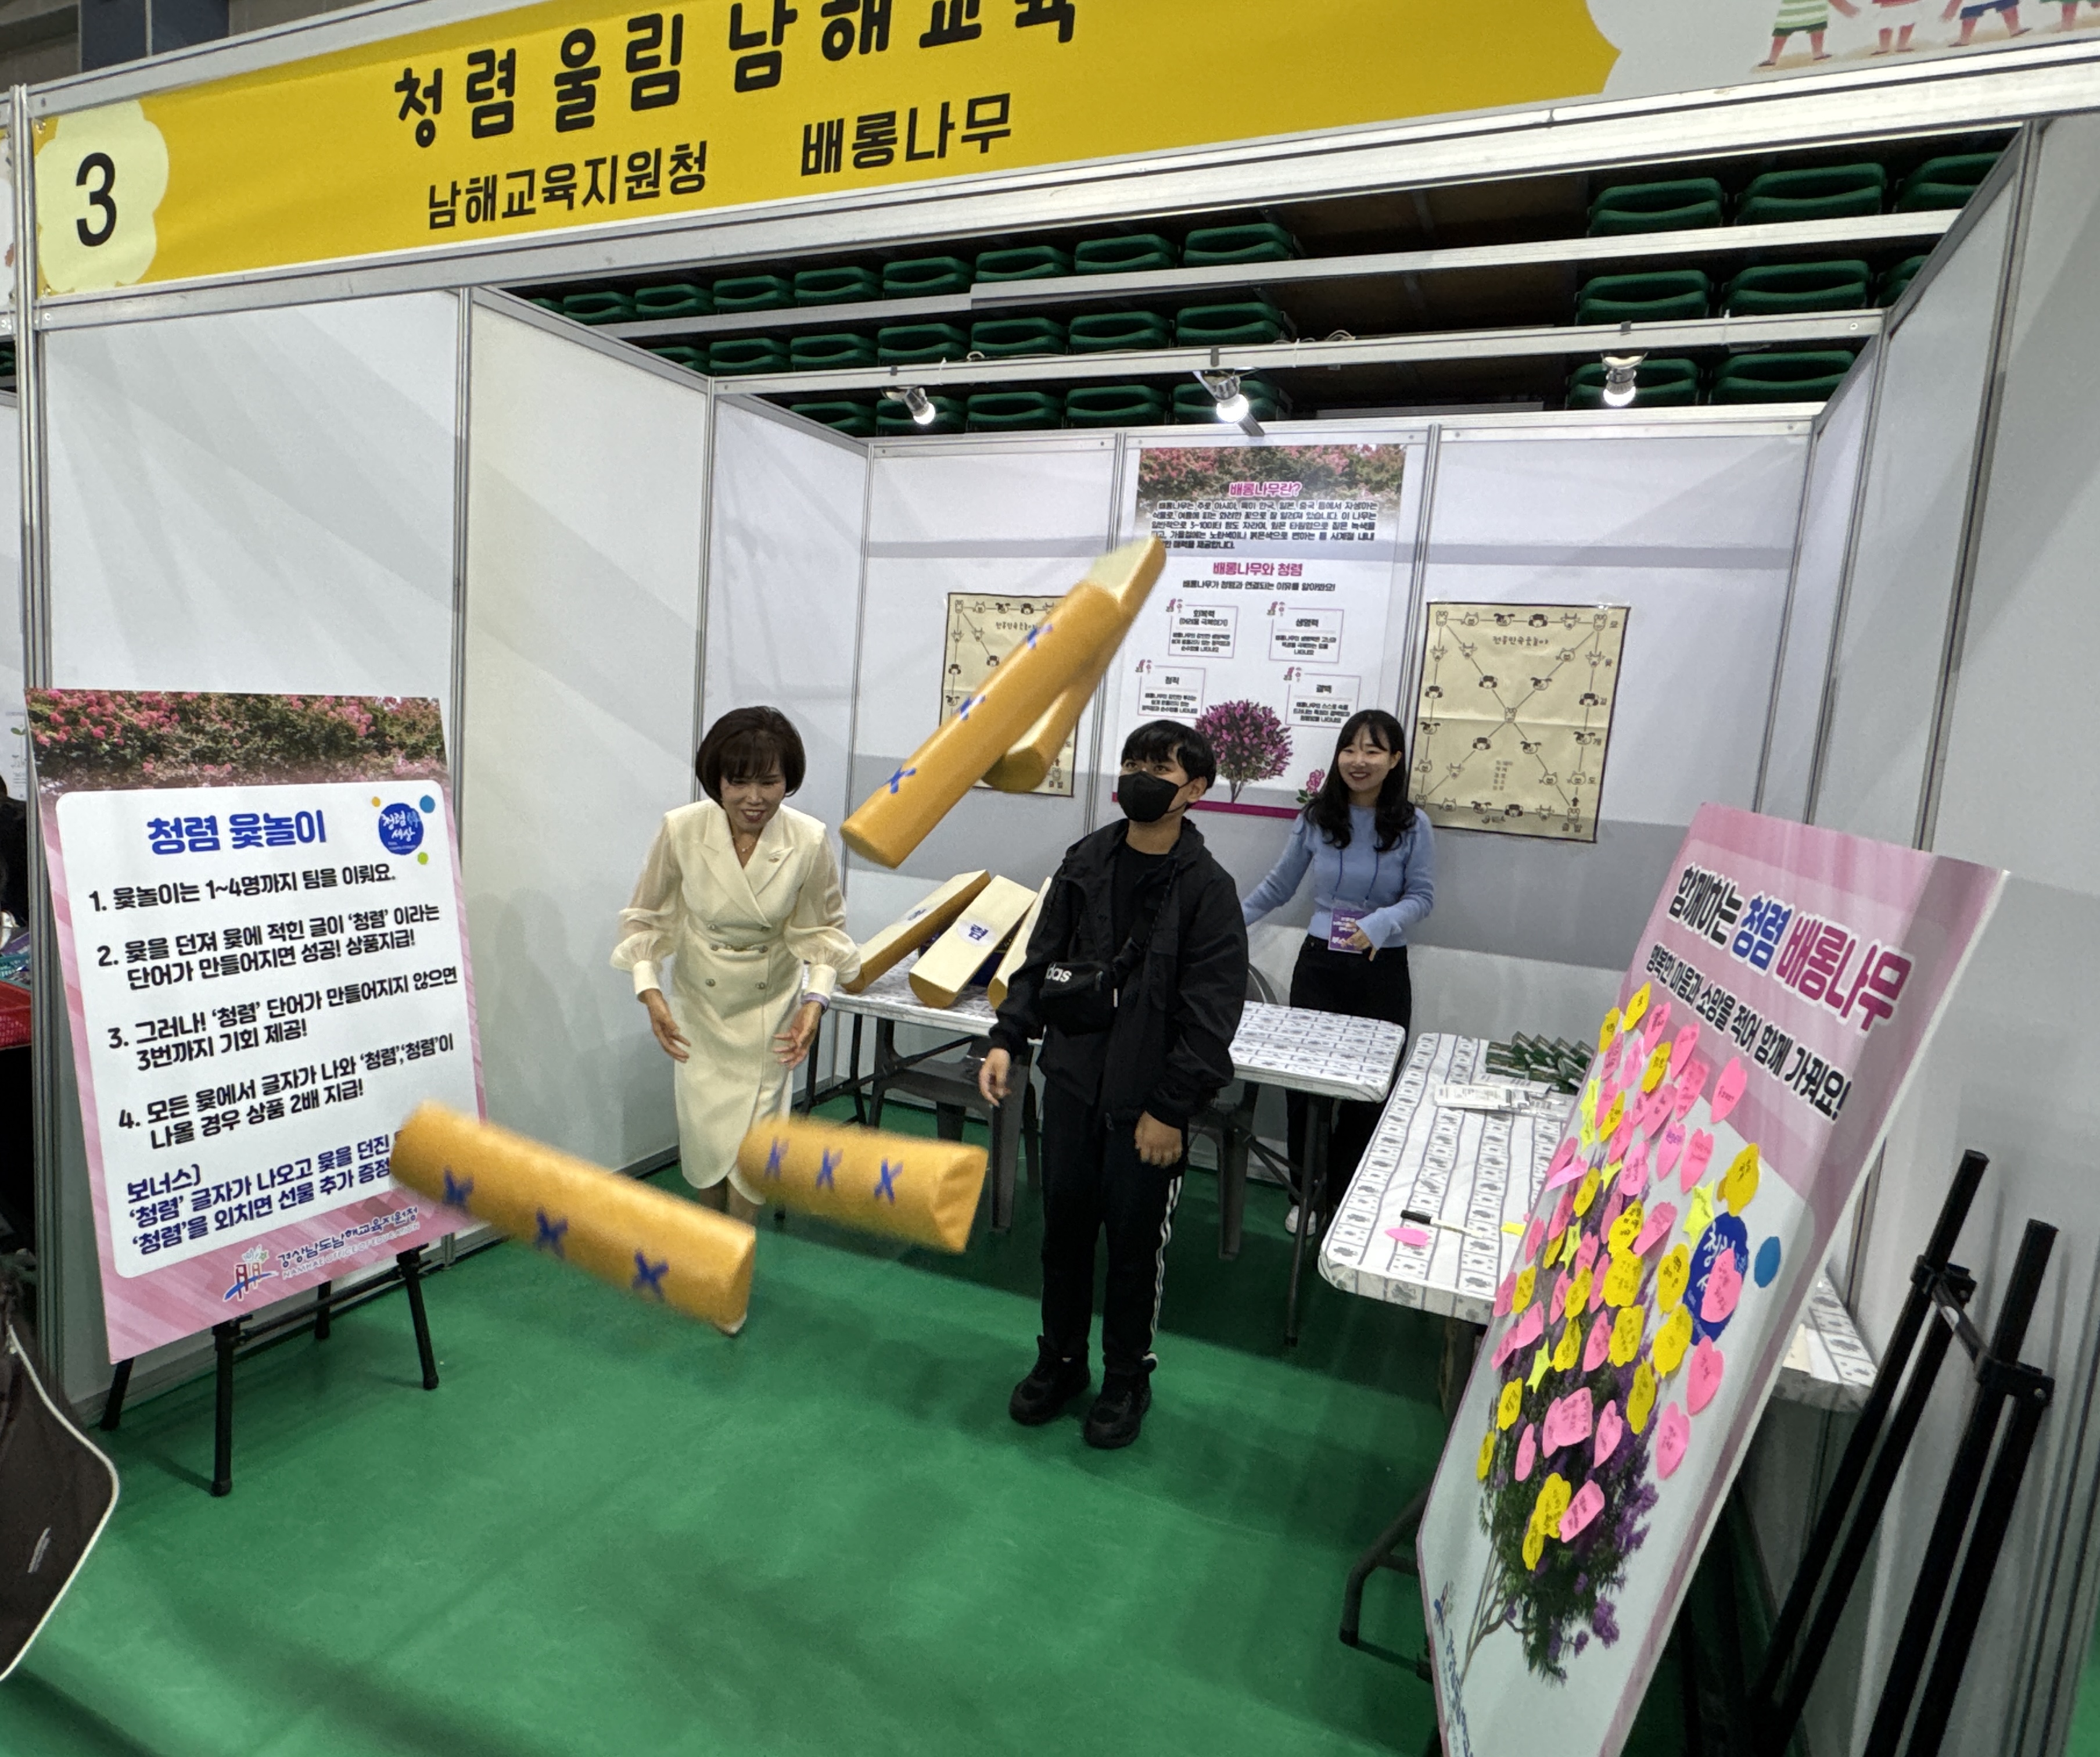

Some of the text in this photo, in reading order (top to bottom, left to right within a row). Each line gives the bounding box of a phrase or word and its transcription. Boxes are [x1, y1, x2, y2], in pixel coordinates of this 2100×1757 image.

[394, 48, 517, 148] 청렴
[554, 13, 684, 133] 울림
[429, 93, 1011, 230] 남해교육지원청 배롱나무
[76, 153, 116, 246] 3
[1230, 482, 1301, 496] 배롱나무란?
[1213, 562, 1302, 576] 배롱나무와 청렴
[146, 809, 326, 855] 청렴 윷놀이
[89, 863, 396, 912] 1. 윷놀이는 1~4명까지 팀을 이뤄요.
[97, 945, 119, 966] 2.
[125, 937, 170, 963] 윷을
[175, 931, 218, 956] 던져
[223, 925, 263, 950] 윷에
[267, 920, 305, 942] 적힌
[309, 915, 344, 937] 글이
[394, 904, 440, 924] 이라는
[127, 929, 415, 991] 단어가 만들어지면 성공! 상품지급!
[1669, 866, 1912, 1031] 함께하는 청렴 배롱나무
[1046, 964, 1072, 983] das
[107, 1027, 129, 1048] 3.
[135, 1012, 206, 1044] 그러나!
[267, 991, 322, 1019] 단어가
[327, 975, 409, 1007] 만들어지지
[413, 966, 458, 991] 않으면
[137, 1019, 307, 1071] 3번까지 기회 제공!
[1670, 961, 1704, 1006] 마음과
[1696, 983, 1736, 1031] 소망을
[1731, 1004, 1762, 1052] 적어
[1754, 1024, 1794, 1077] 함께
[1784, 1046, 1851, 1121] 가꿔요!
[119, 1109, 141, 1128] 4.
[148, 1095, 189, 1124] 모든
[196, 1079, 256, 1112] 윷에서
[261, 1065, 317, 1096] 글자가
[322, 1056, 356, 1081] 나와
[150, 1078, 363, 1149] 나올 경우 상품 2배 지급!
[191, 1175, 252, 1212] 글자가
[257, 1158, 313, 1191] 나오고
[318, 1146, 353, 1174] 윷을
[357, 1134, 390, 1160] 던진
[214, 1195, 273, 1231] 외치면
[278, 1182, 314, 1210] 선물
[320, 1169, 354, 1195] 추가
